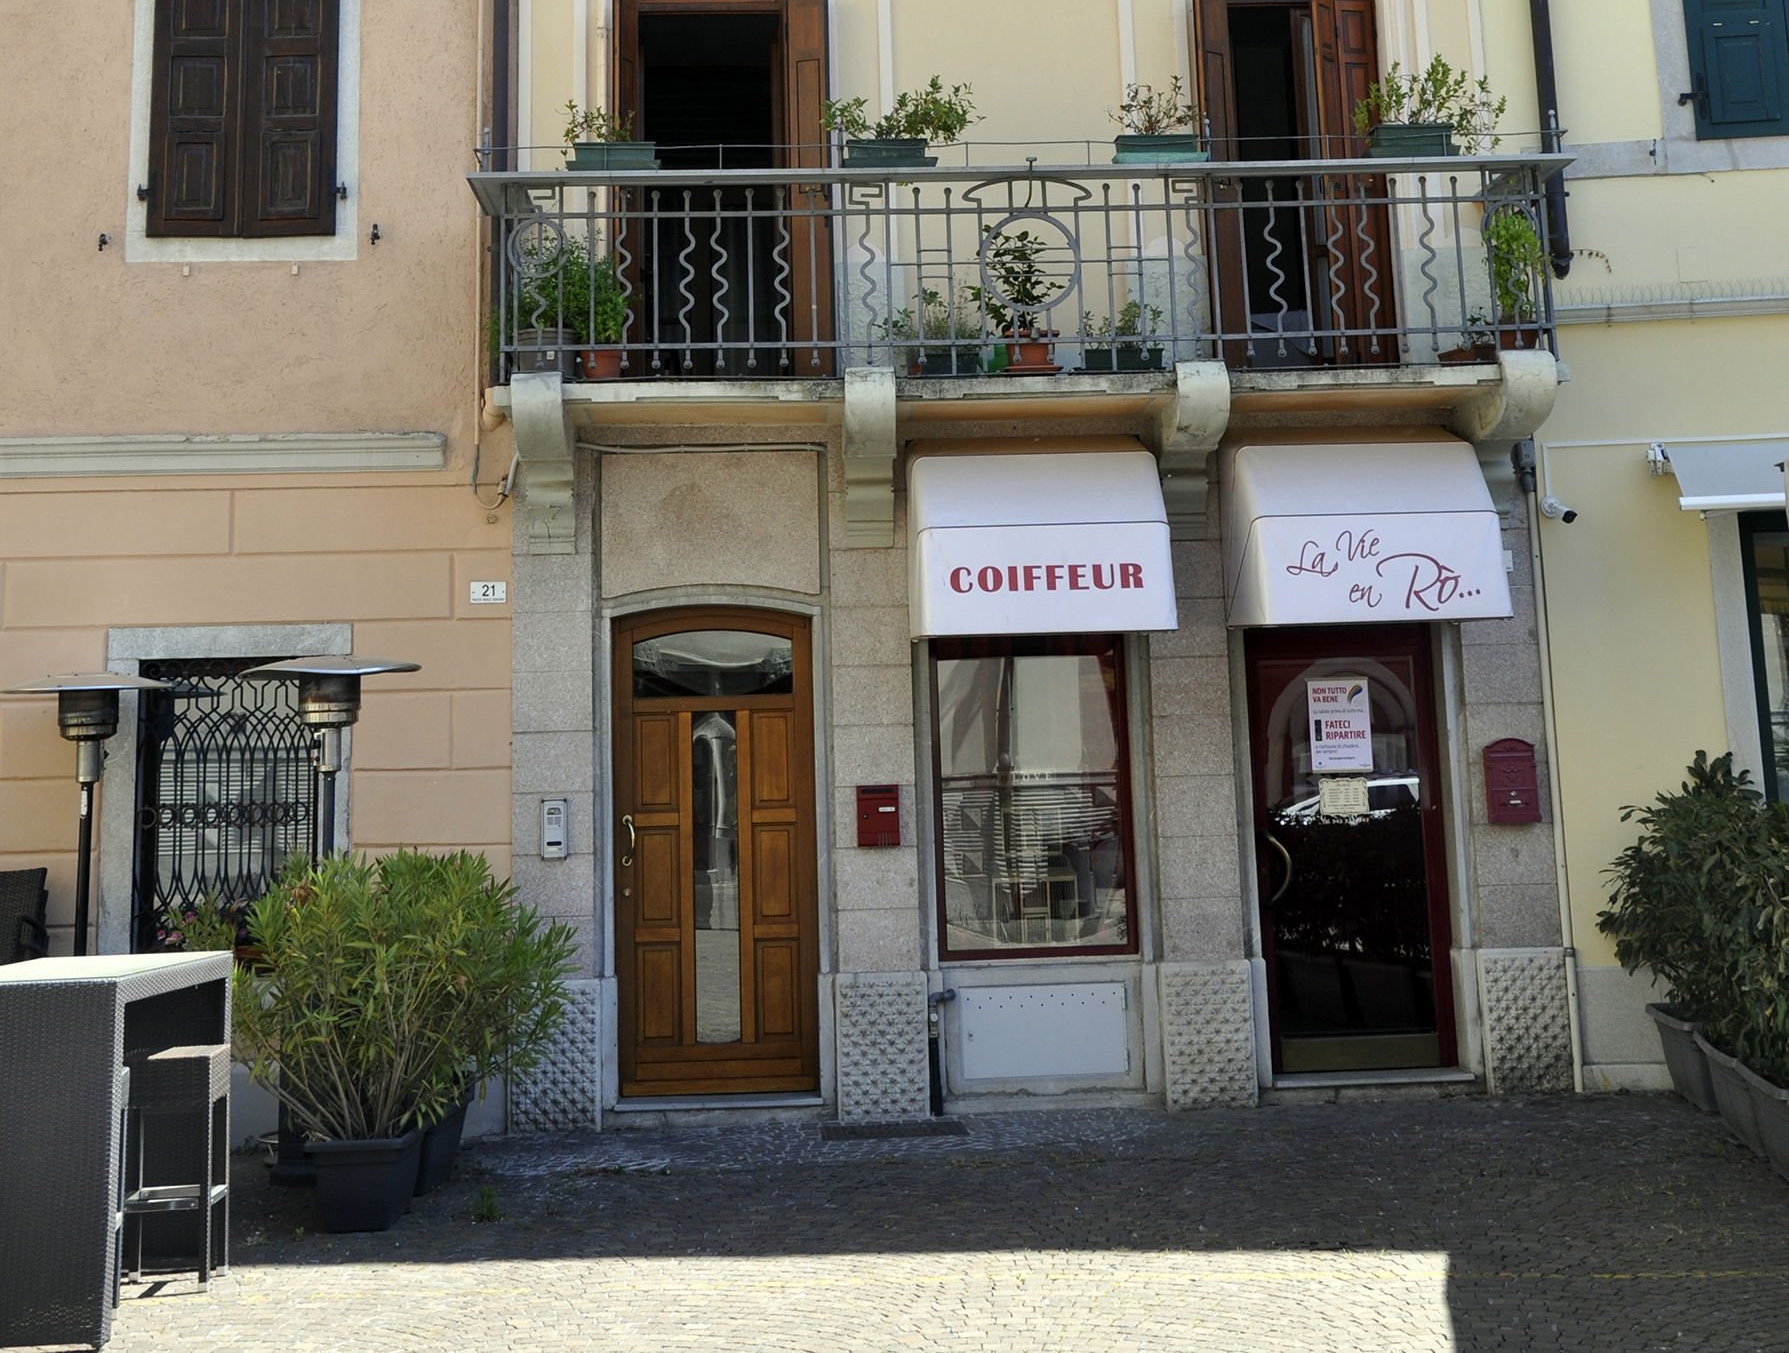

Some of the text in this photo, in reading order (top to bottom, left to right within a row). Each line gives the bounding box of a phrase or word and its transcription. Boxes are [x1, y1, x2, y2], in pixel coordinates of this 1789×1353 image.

[1286, 529, 1380, 577] La Vie
[949, 563, 1144, 593] COIFFEUR
[482, 584, 495, 596] 21
[1349, 583, 1382, 608] en
[1325, 720, 1350, 729] FATECI
[1326, 730, 1366, 740] RIPARTIRE
[1011, 771, 1052, 782] LOVE
